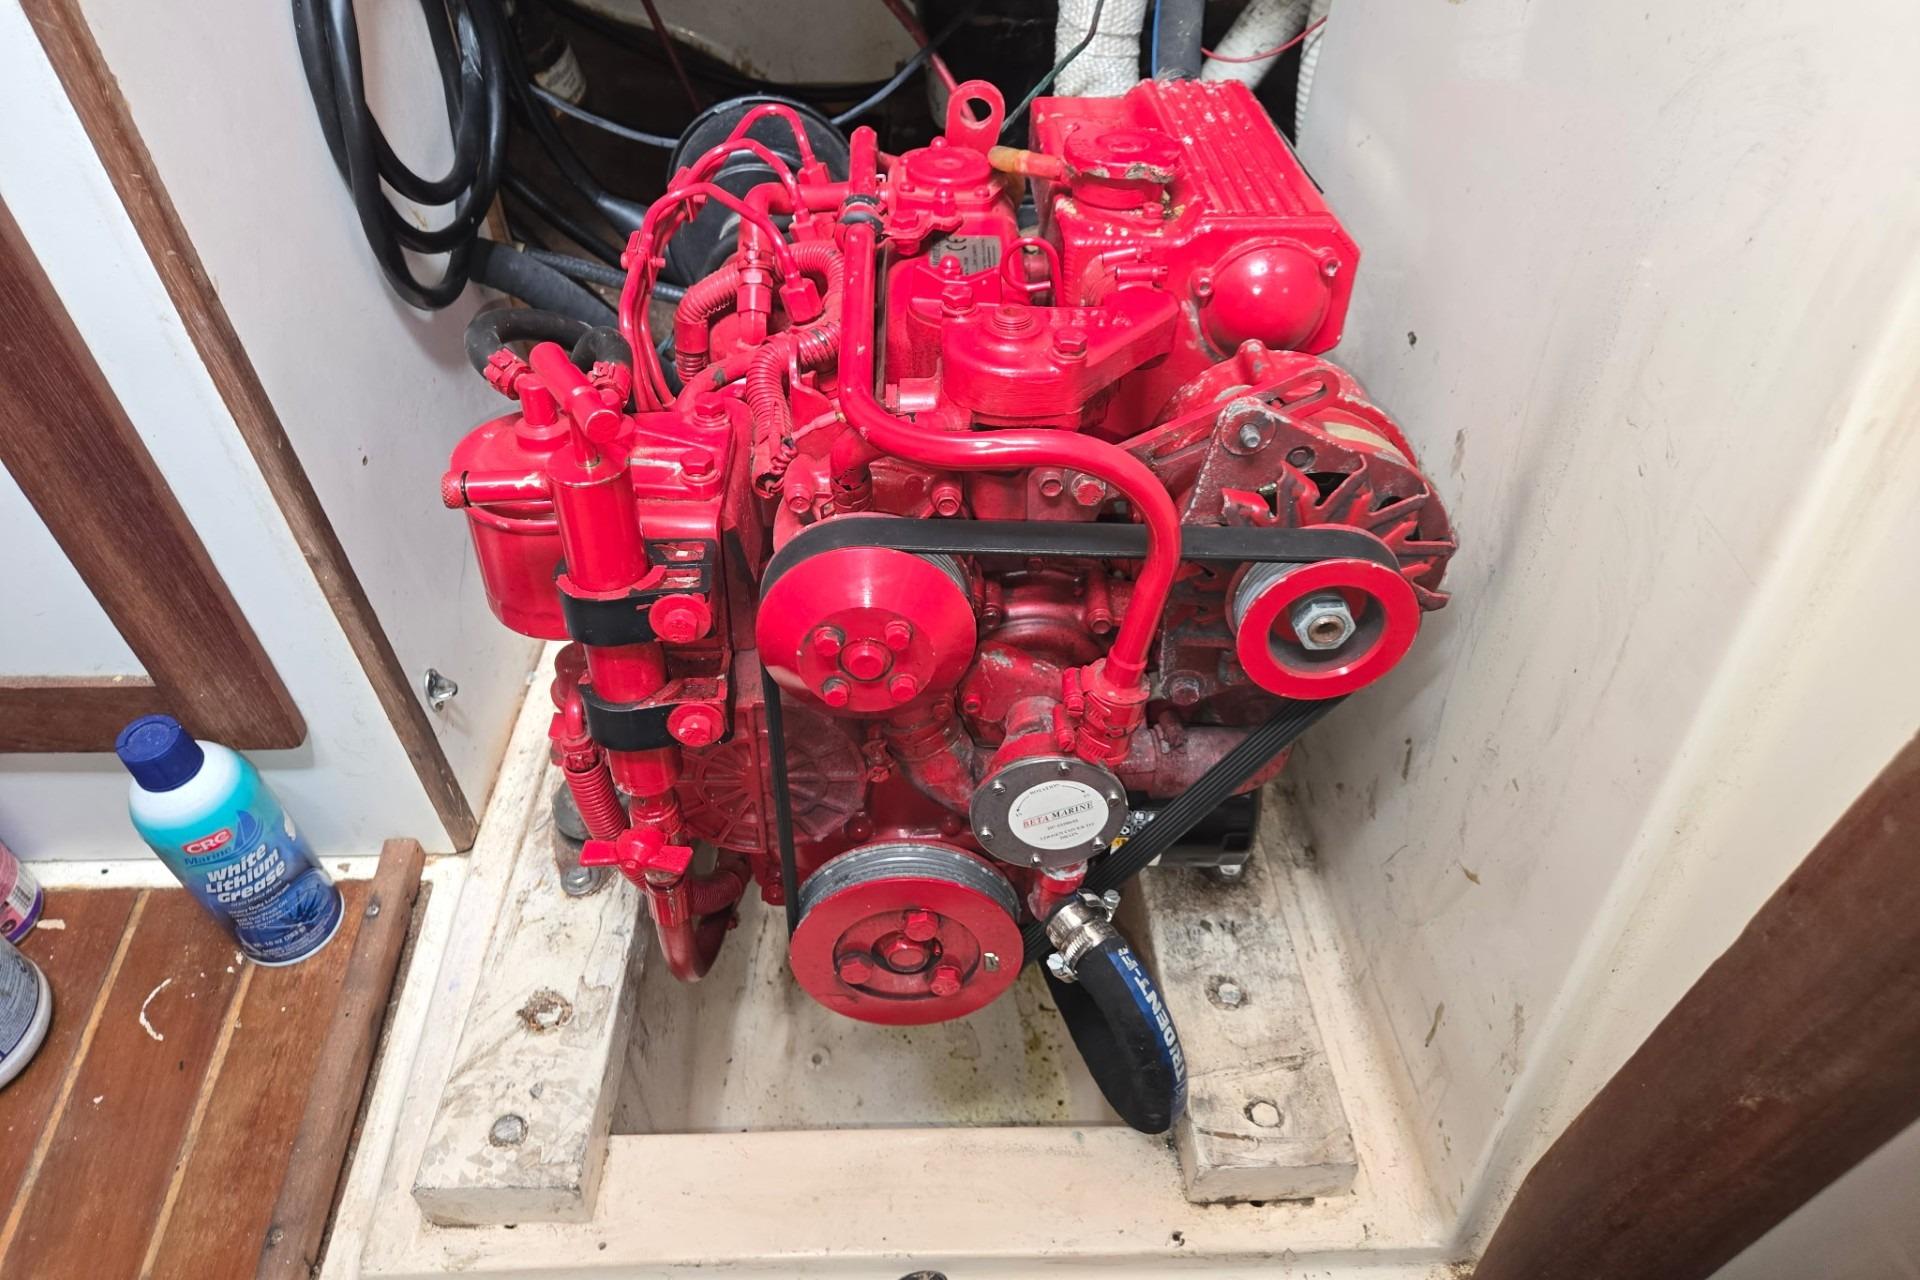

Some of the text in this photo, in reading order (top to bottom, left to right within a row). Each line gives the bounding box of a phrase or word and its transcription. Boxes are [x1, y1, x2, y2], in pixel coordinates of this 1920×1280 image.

[1023, 814, 1050, 829] BETA
[1052, 801, 1094, 820] MARINE
[184, 847, 231, 866] Marine
[186, 830, 231, 853] CRC
[205, 848, 280, 894] Lithium
[206, 843, 267, 882] White
[217, 860, 286, 903] Grease
